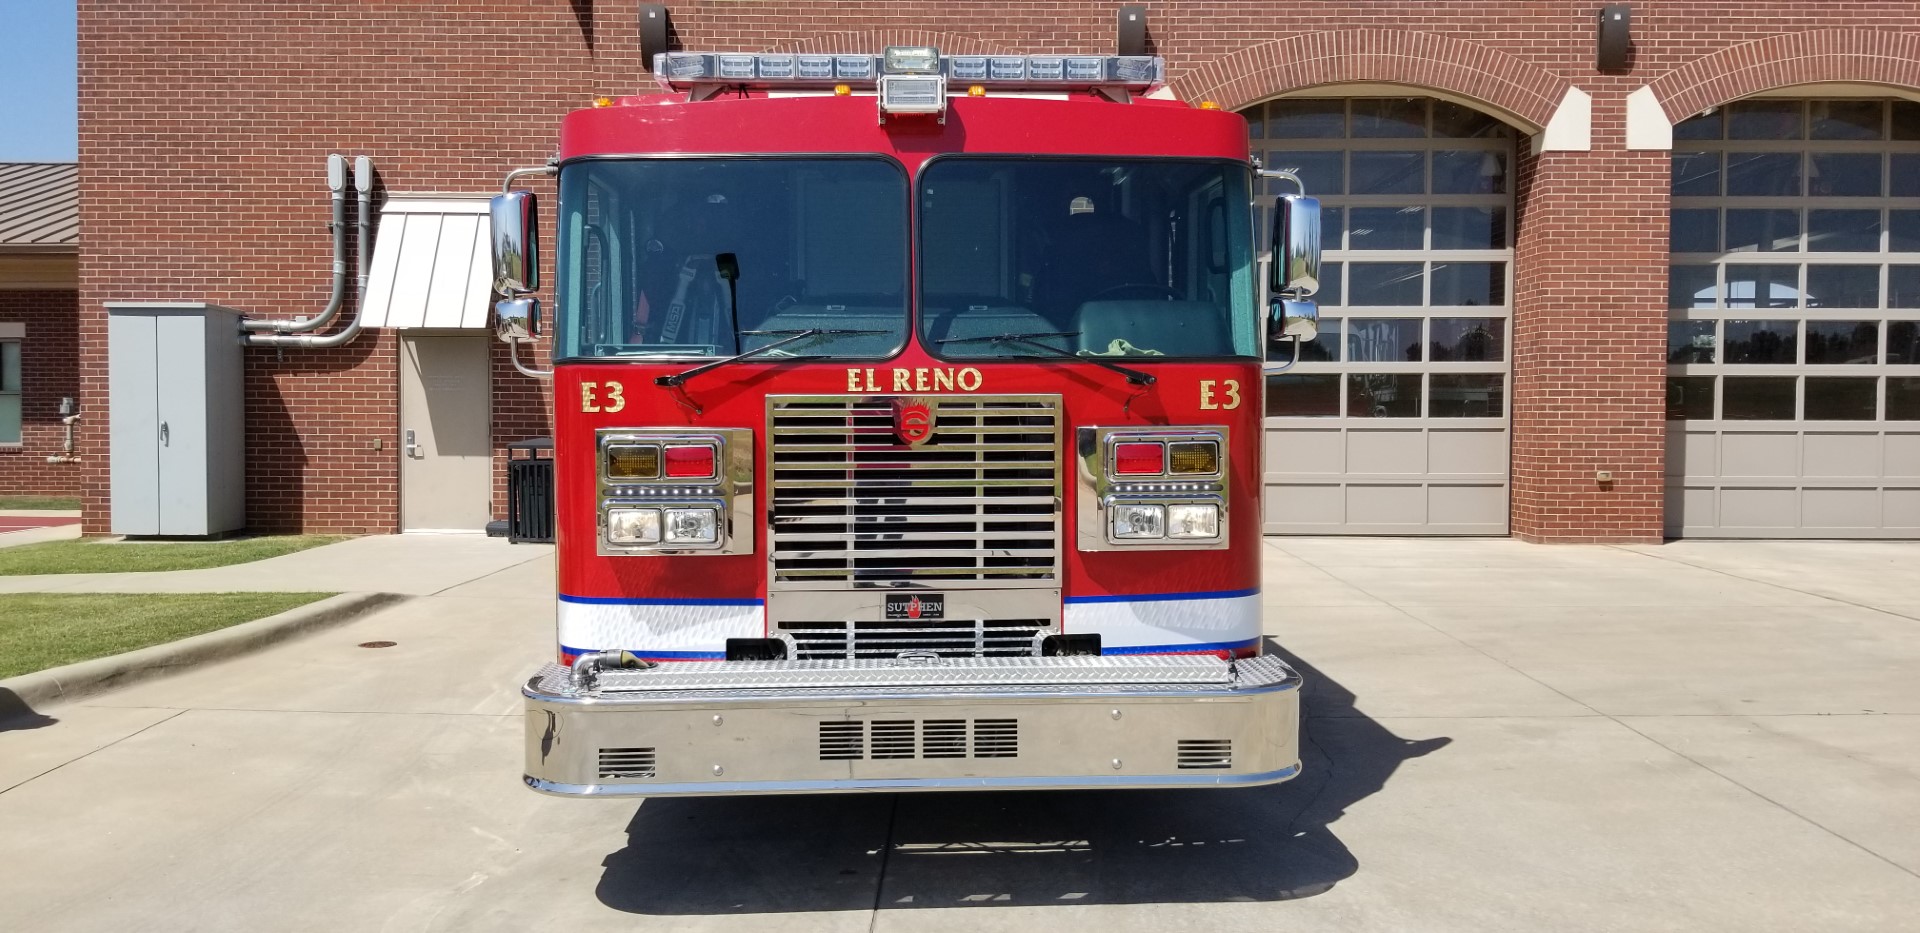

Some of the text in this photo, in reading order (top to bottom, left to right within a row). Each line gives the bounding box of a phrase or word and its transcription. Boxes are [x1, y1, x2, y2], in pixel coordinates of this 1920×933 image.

[846, 367, 983, 392] EL RENO
[581, 381, 626, 413] E3
[1200, 379, 1242, 410] E3
[887, 602, 942, 612] SUTPHEN
